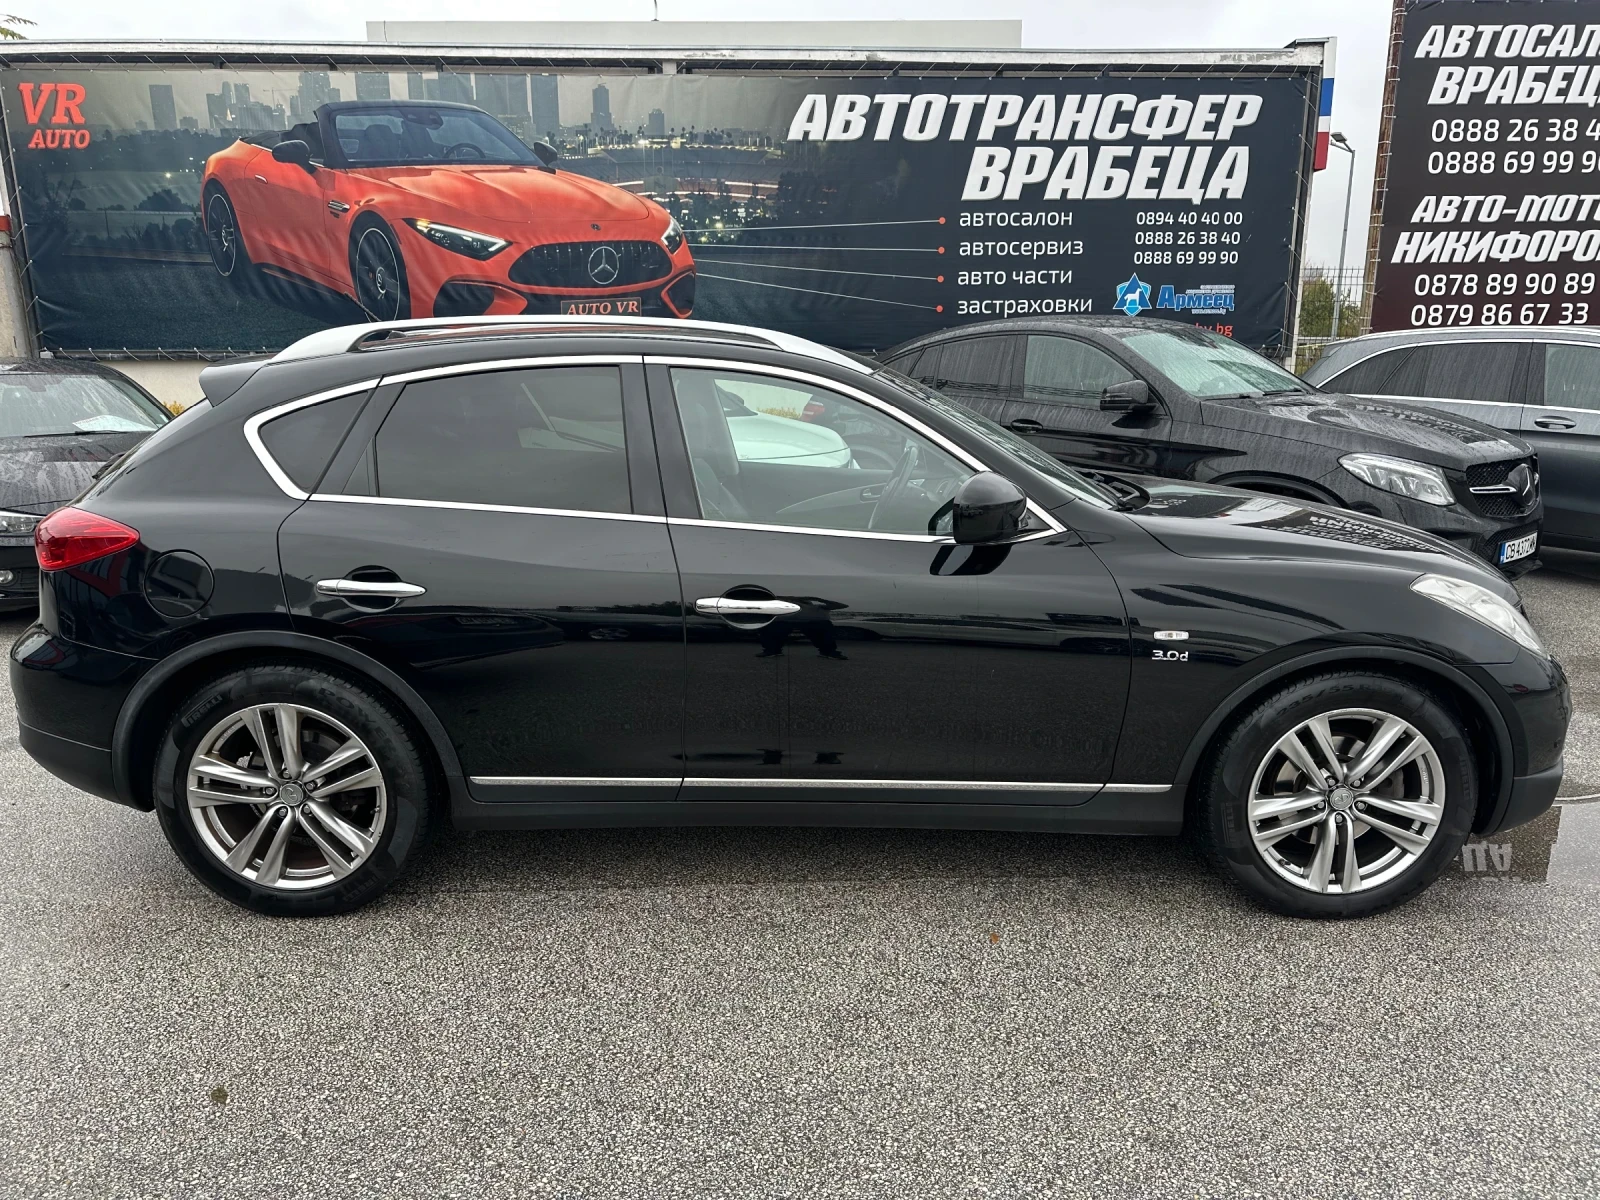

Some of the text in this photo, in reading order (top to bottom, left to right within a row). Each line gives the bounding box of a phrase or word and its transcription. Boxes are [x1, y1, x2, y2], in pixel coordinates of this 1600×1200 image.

[1414, 24, 1600, 59] АВТОСАЛ
[1427, 65, 1600, 107] ВРАБЕЦ
[18, 82, 86, 125] VR
[787, 93, 1264, 142] АВТОТРАНСФЕР
[27, 129, 91, 149] AUTO
[1431, 119, 1499, 142] 0888
[1506, 118, 1539, 142] 26
[1545, 118, 1579, 142] 38
[1427, 150, 1600, 175] 0888 69 99 9
[961, 145, 1250, 205] ВРАБЕЦА
[959, 212, 1073, 227] автосалон
[1136, 211, 1243, 225] 0894 40 40 00
[959, 240, 1084, 260] автосервиз
[1135, 231, 1241, 245] 0888 26 38 40
[1390, 229, 1600, 264] НИКИФОРО
[1133, 251, 1239, 265] 0888 69 99 90
[957, 270, 1072, 285] авто части
[1414, 272, 1596, 296] 0878 89 90 89
[567, 300, 639, 315] AUTO VR
[957, 298, 1093, 318] застраховки
[1156, 285, 1235, 311] Армеец
[1410, 302, 1589, 326] 0879 86 67 33
[1151, 650, 1189, 662] 3.0d
